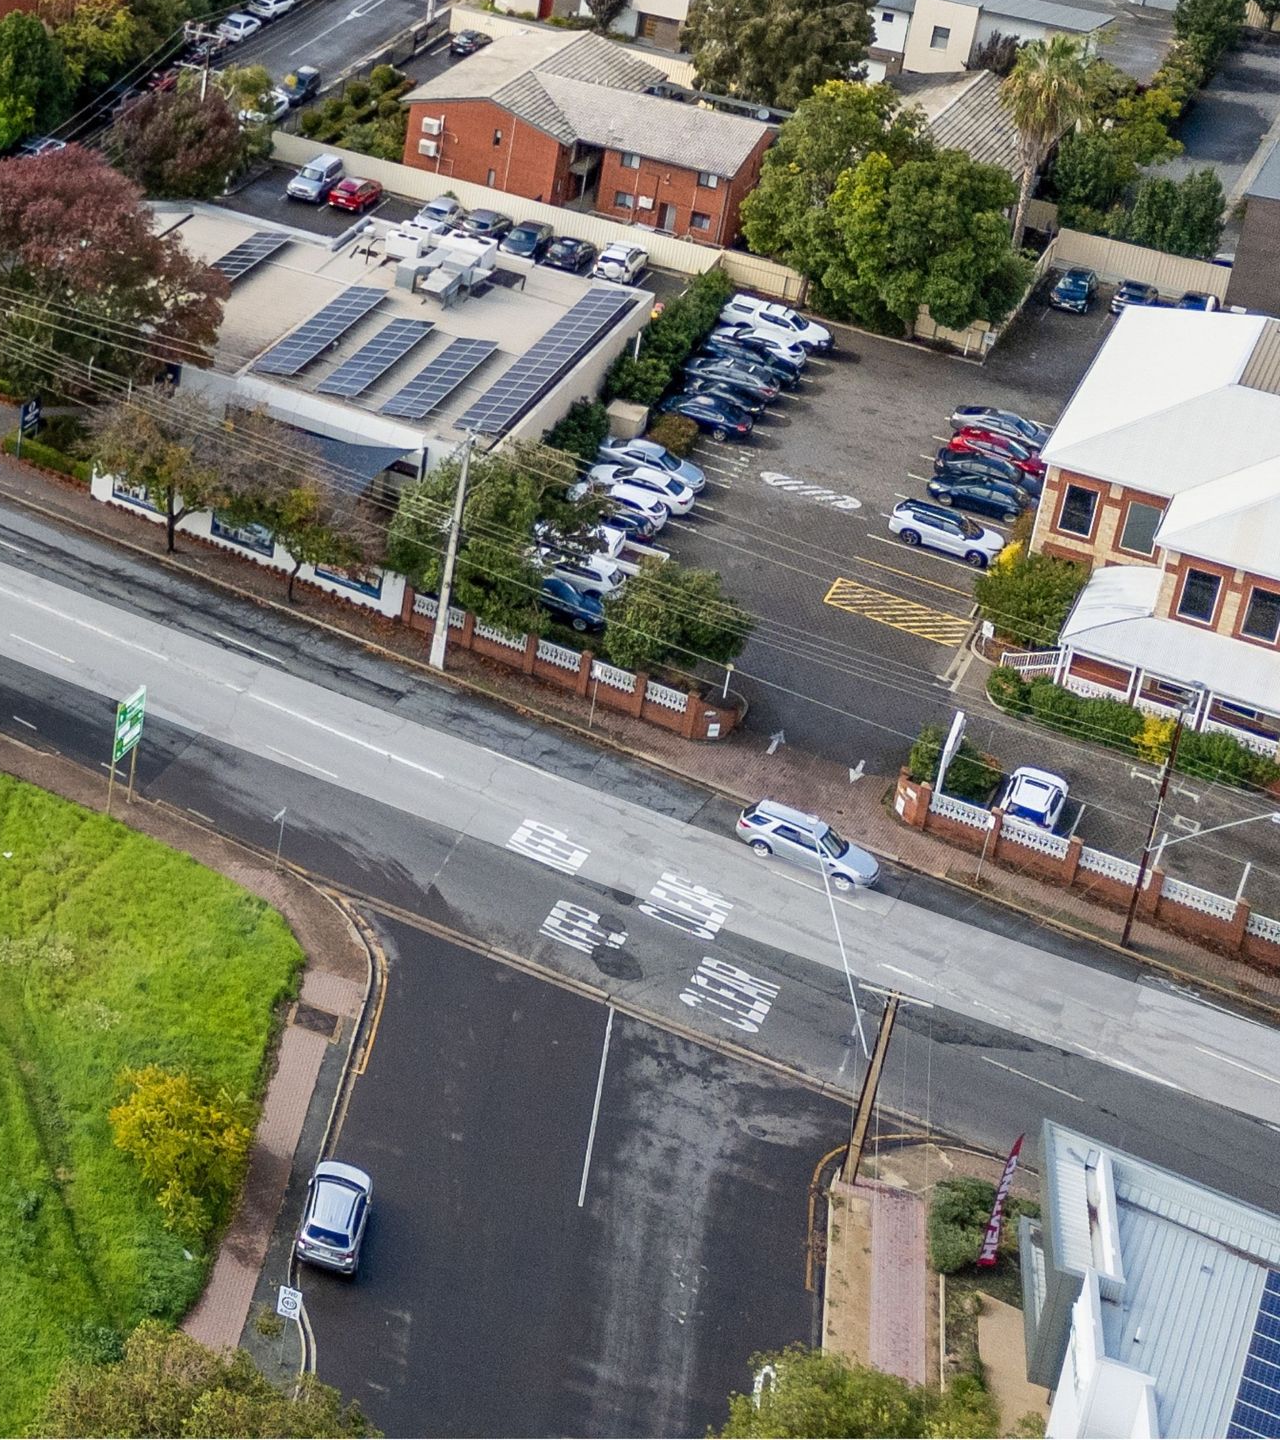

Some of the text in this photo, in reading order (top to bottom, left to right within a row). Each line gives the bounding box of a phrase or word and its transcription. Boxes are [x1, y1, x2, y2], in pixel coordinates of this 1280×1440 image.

[505, 818, 591, 876] KEEP
[539, 899, 629, 954] KEEP
[679, 956, 781, 1033] CLEAR
